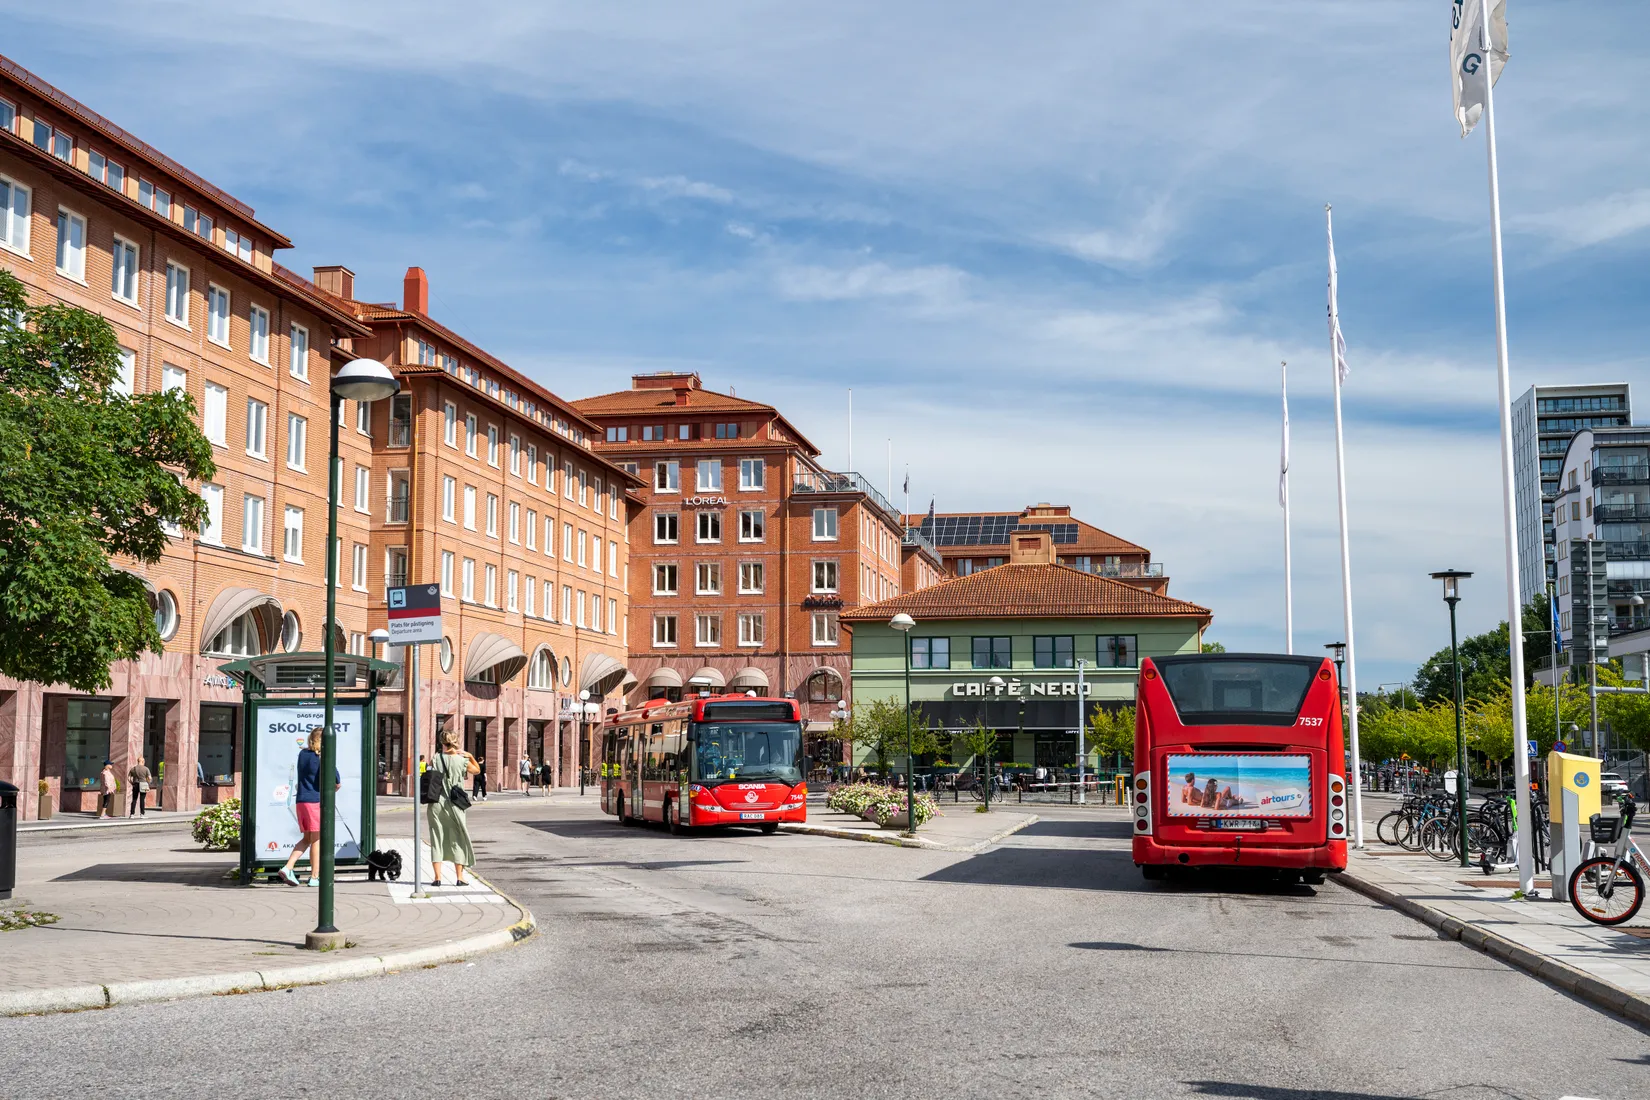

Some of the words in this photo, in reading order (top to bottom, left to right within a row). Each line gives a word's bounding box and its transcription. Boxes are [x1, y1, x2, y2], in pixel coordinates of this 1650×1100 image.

[1030, 682, 1092, 696] NERO
[268, 722, 350, 733] SKOLSRT
[1300, 718, 1323, 726] 7537
[1260, 794, 1296, 805] airtours
